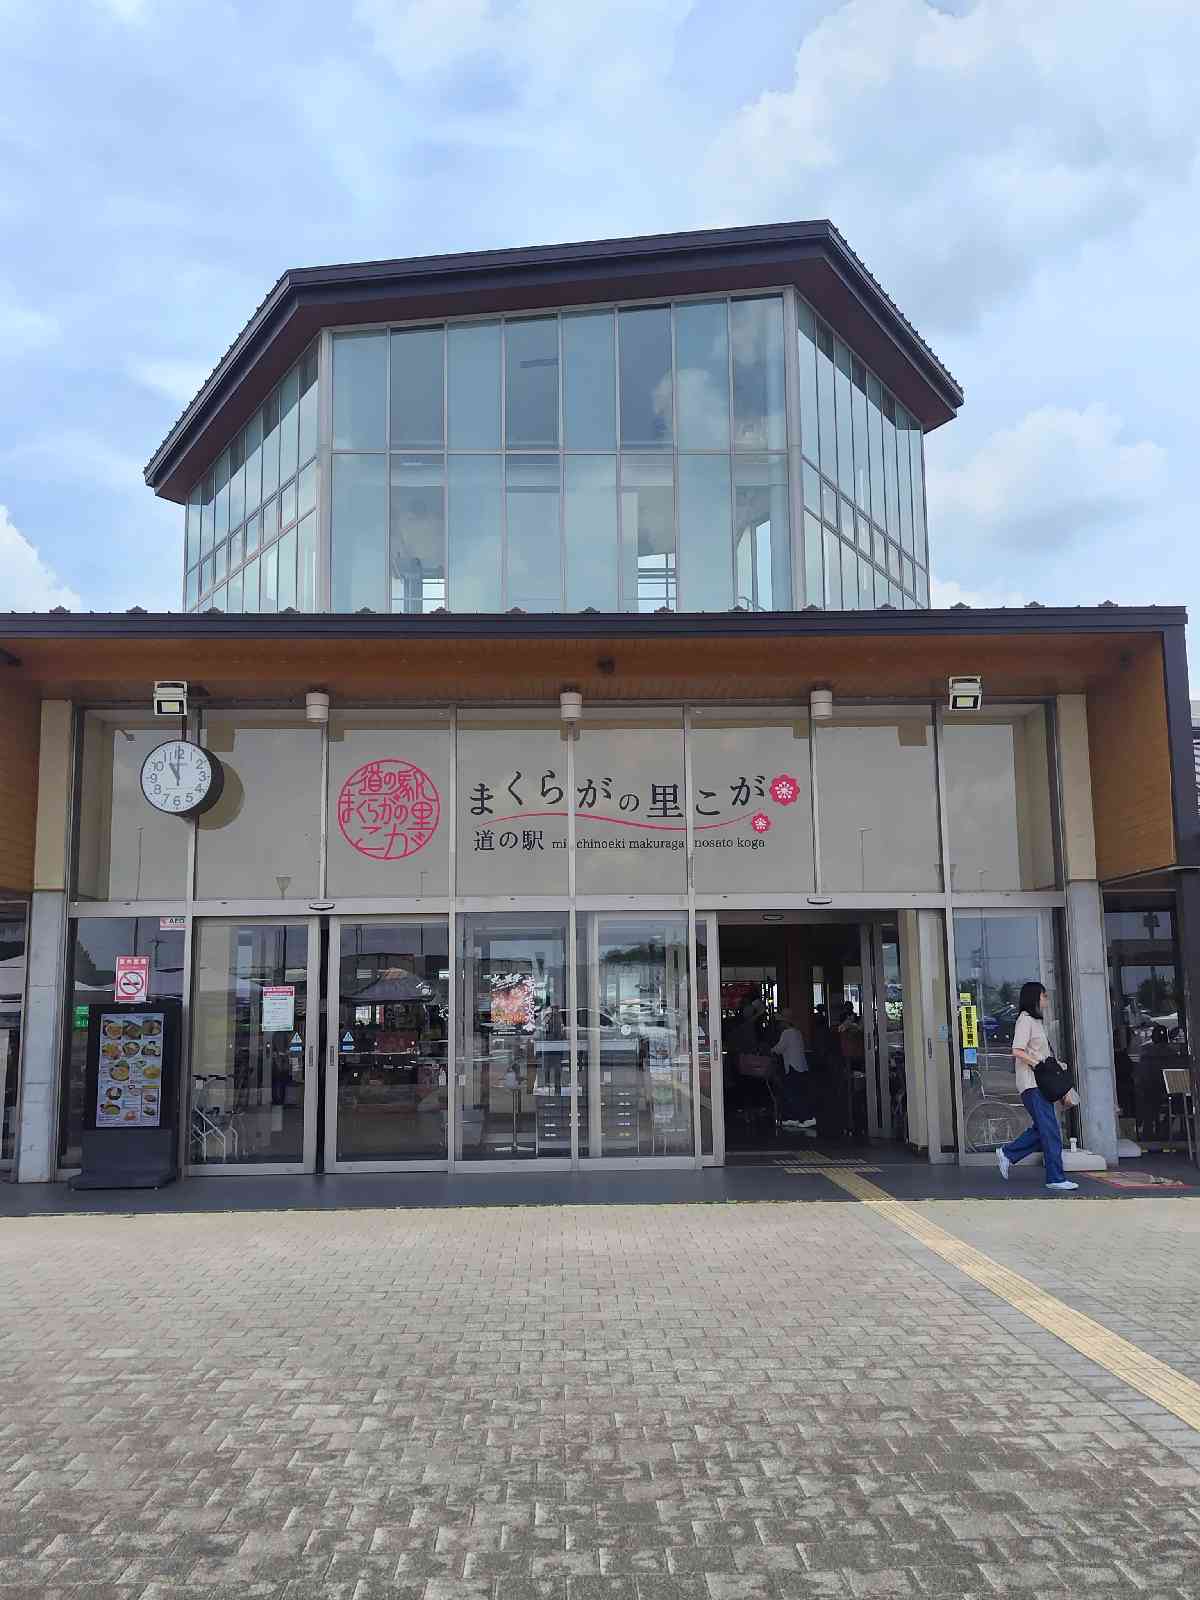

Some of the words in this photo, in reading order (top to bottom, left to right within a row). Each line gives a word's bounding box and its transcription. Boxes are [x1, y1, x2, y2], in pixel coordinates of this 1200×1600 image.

[153, 760, 164, 772] 10
[196, 759, 204, 770] 2
[150, 773, 158, 783] 9
[199, 771, 206, 782] 3
[350, 763, 438, 803] 道の駅
[154, 784, 161, 795] 8
[195, 784, 205, 794] 4
[469, 769, 766, 817] まくらがの里こが
[162, 793, 170, 804] 7
[173, 796, 181, 807] 6
[185, 792, 193, 803] 5
[473, 830, 545, 852] 道の駅
[737, 837, 765, 850] koga
